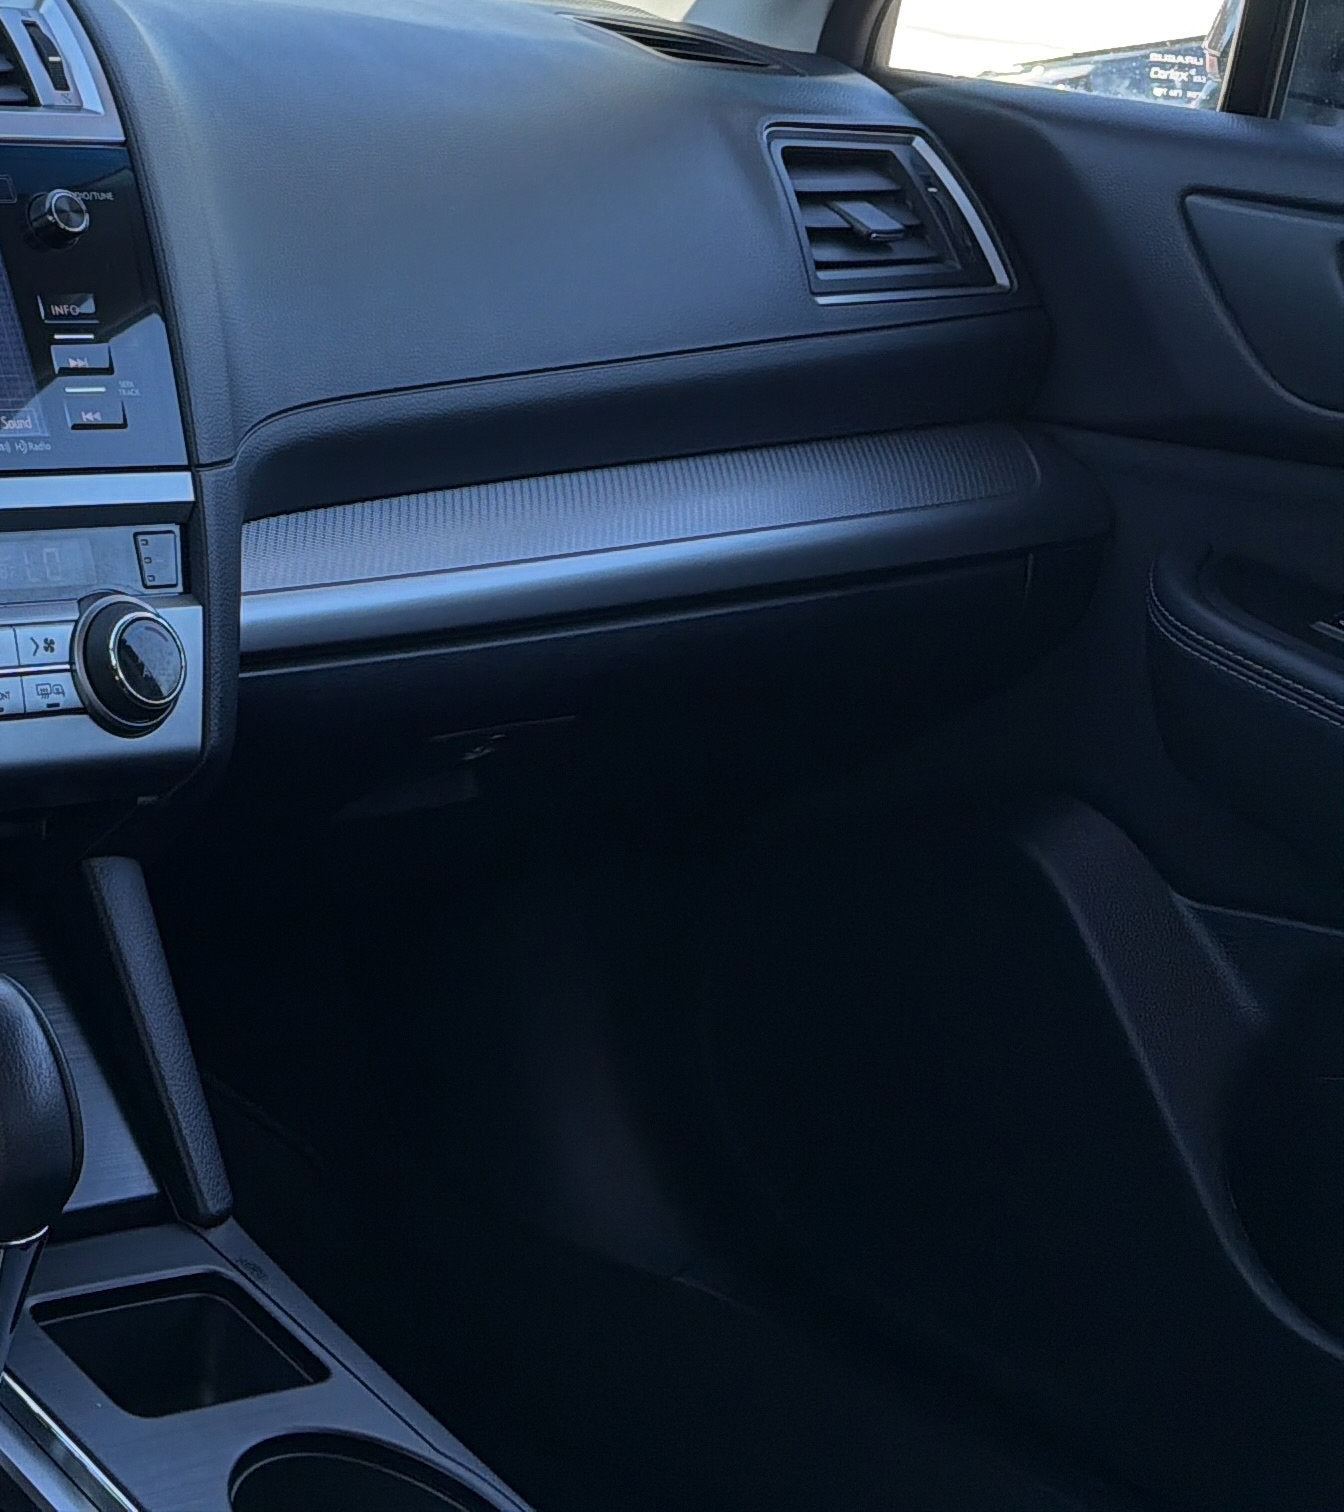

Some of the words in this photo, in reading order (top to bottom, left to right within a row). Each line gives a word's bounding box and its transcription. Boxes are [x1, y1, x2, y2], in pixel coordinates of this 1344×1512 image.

[50, 304, 80, 316] INFO
[1, 416, 33, 430] Sound
[29, 441, 52, 451] Radio
